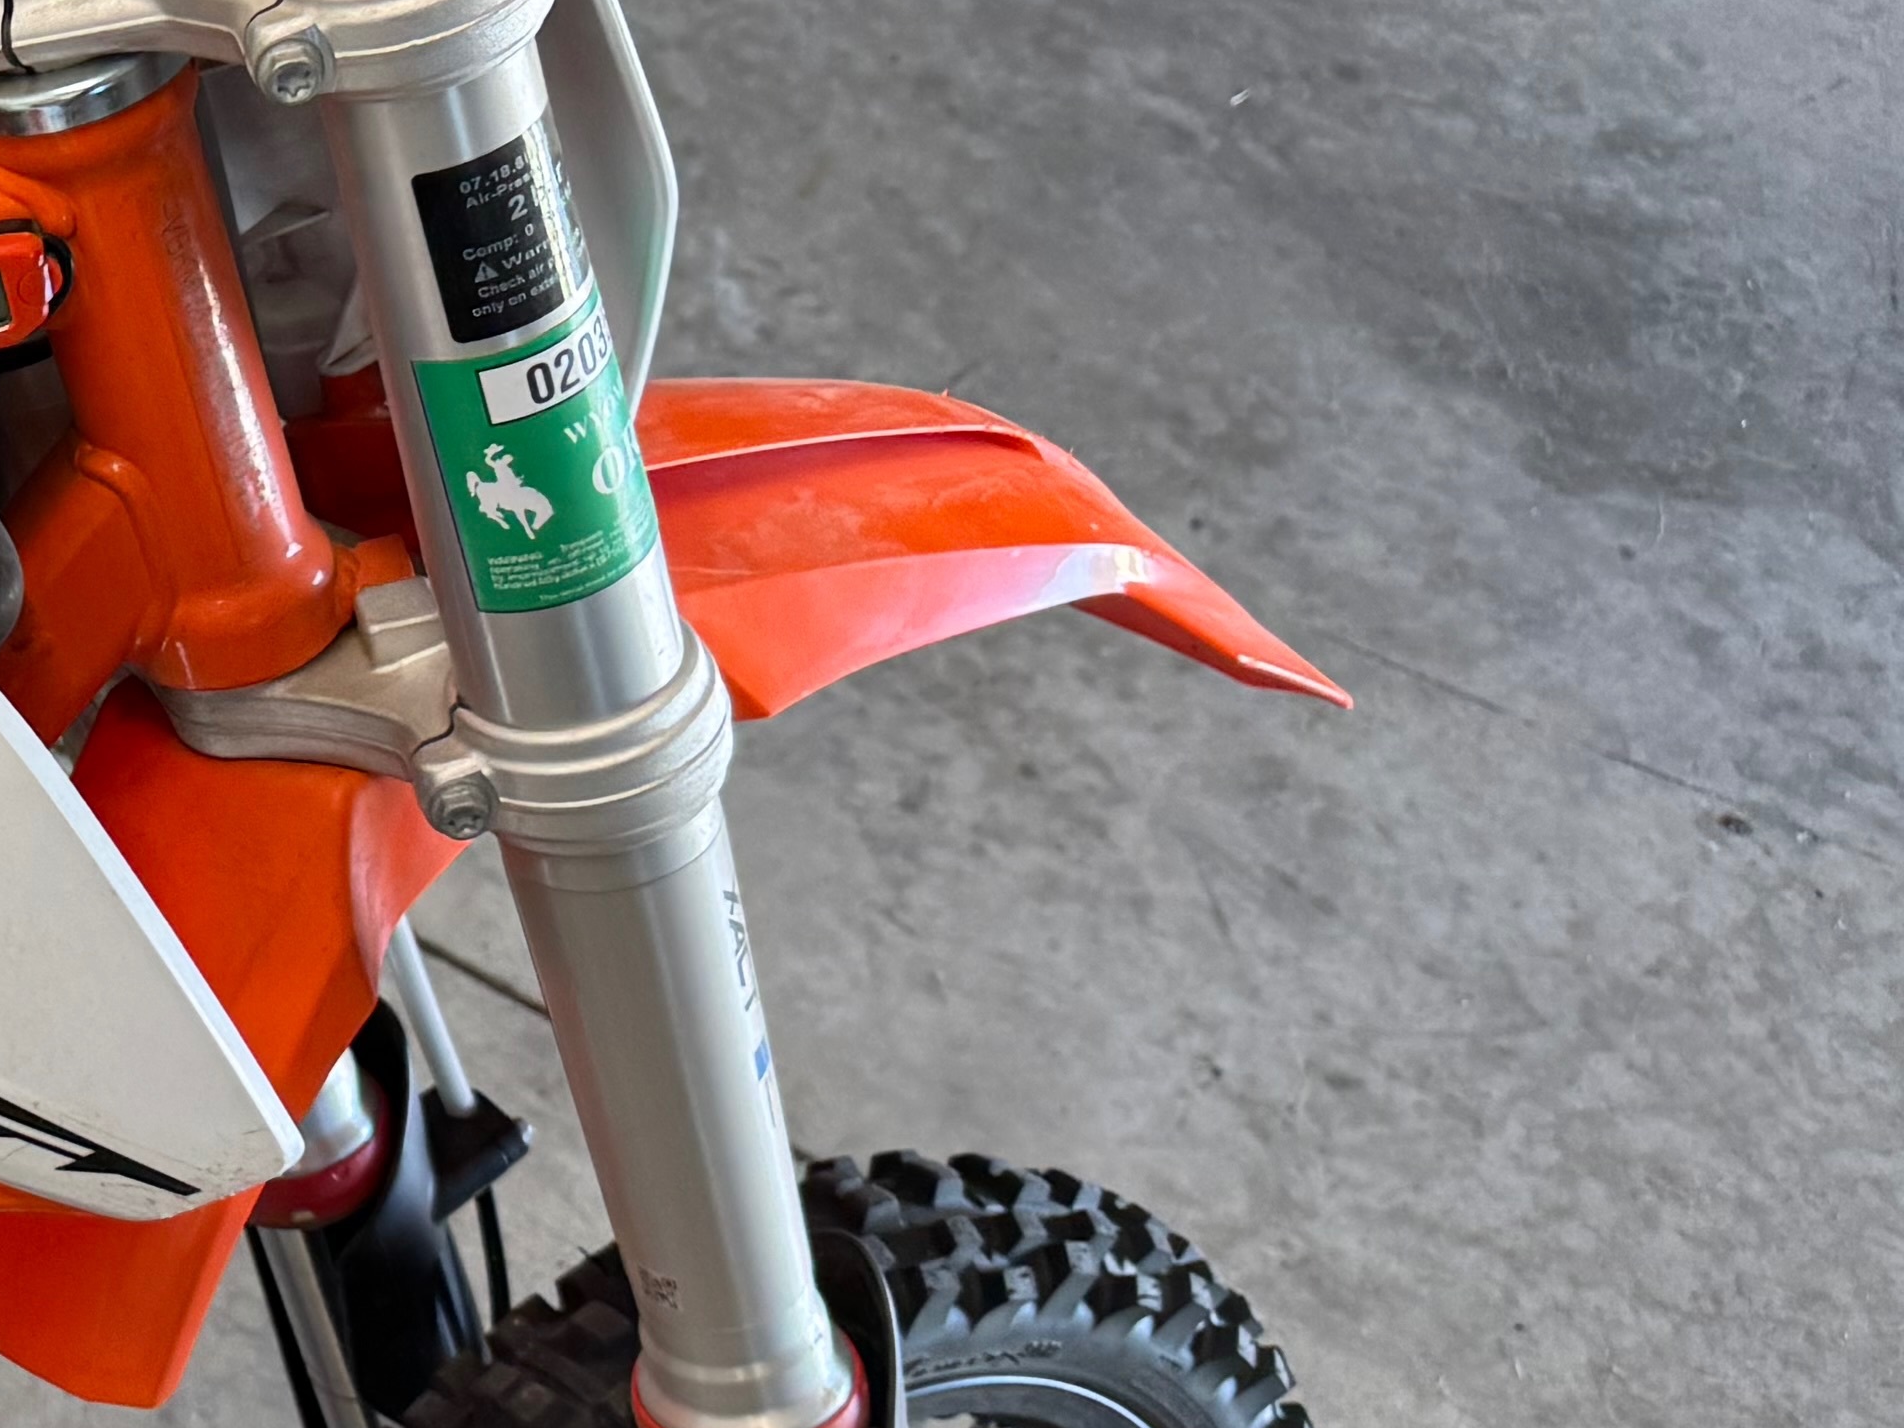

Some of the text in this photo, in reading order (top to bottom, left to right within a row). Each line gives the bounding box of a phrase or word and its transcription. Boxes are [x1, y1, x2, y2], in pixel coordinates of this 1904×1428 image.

[508, 194, 528, 221] 2
[462, 233, 519, 261] Comp:
[477, 273, 526, 298] Check
[472, 299, 506, 319] only
[508, 292, 526, 307] on
